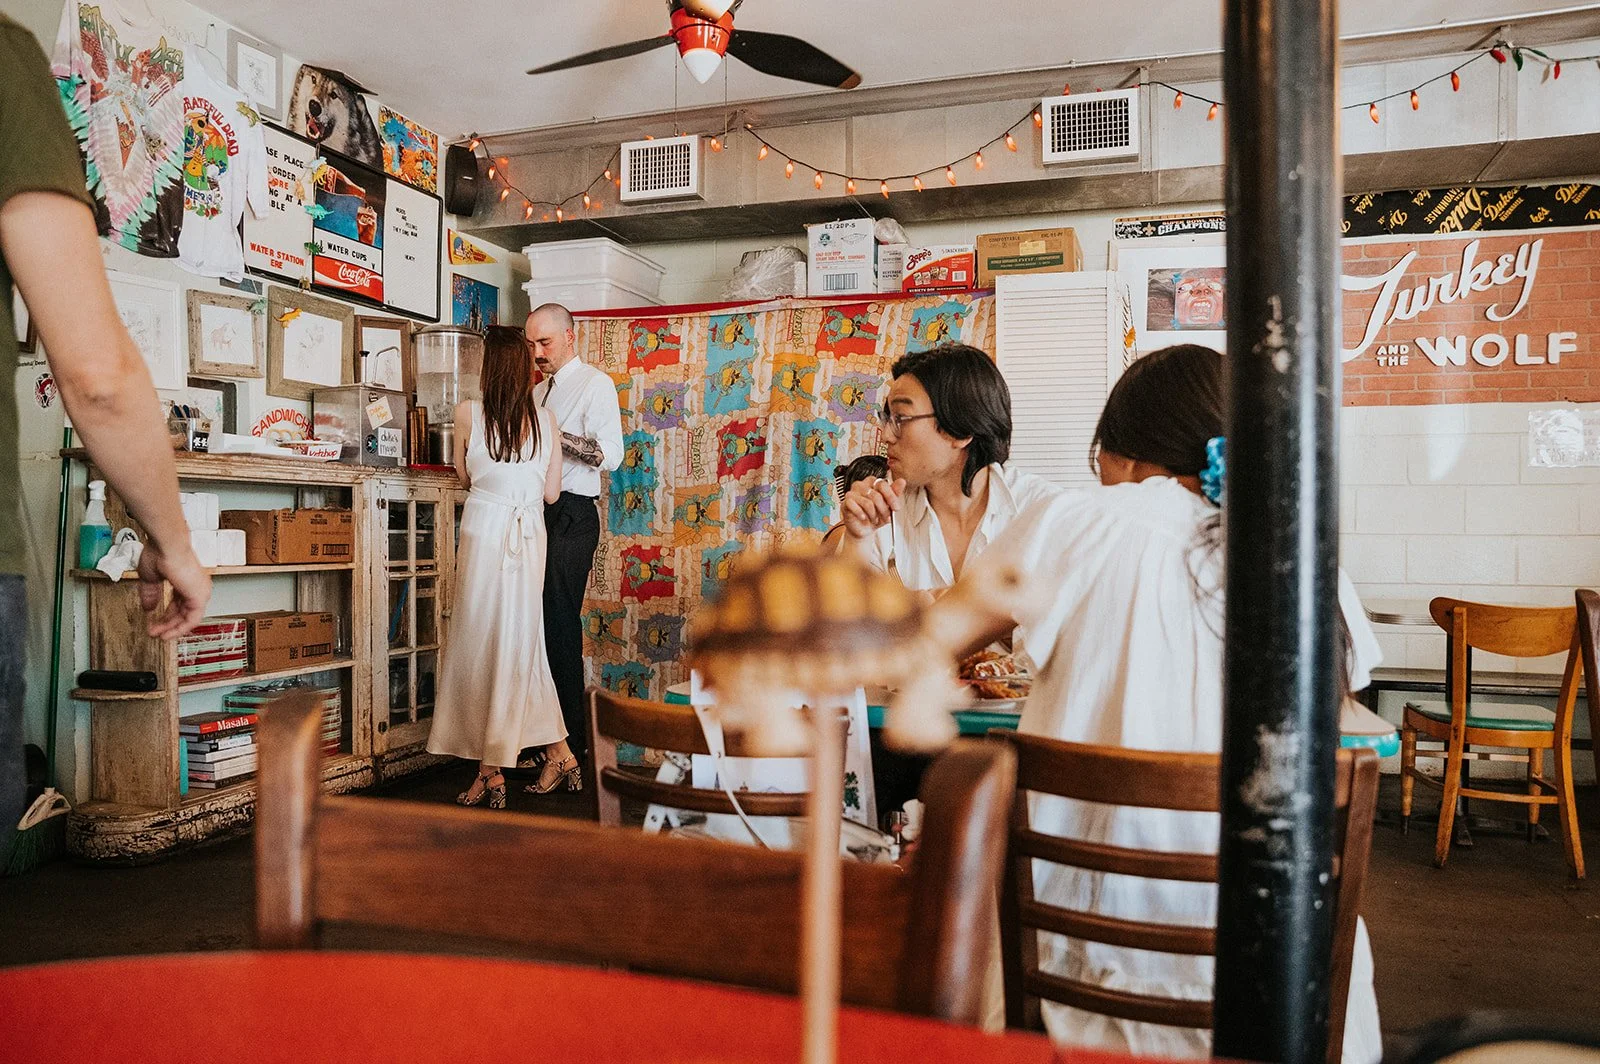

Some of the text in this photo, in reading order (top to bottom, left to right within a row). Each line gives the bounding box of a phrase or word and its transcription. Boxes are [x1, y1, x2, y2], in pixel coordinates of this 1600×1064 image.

[183, 96, 240, 157] RATEFUL DEAD
[283, 153, 304, 169] PLACE
[272, 165, 297, 182] ORDER
[285, 193, 294, 203] AT
[297, 199, 303, 207] A
[1157, 220, 1227, 236] CHAMPIONS
[249, 241, 305, 267] WATER STATION
[326, 241, 368, 262] WATER CUPS
[906, 248, 933, 271] Zapp's
[1341, 238, 1544, 363] Turkey
[1376, 344, 1410, 355] AND
[1415, 331, 1578, 367] WOLF
[1376, 355, 1410, 367] THE
[216, 716, 250, 731] Masala
